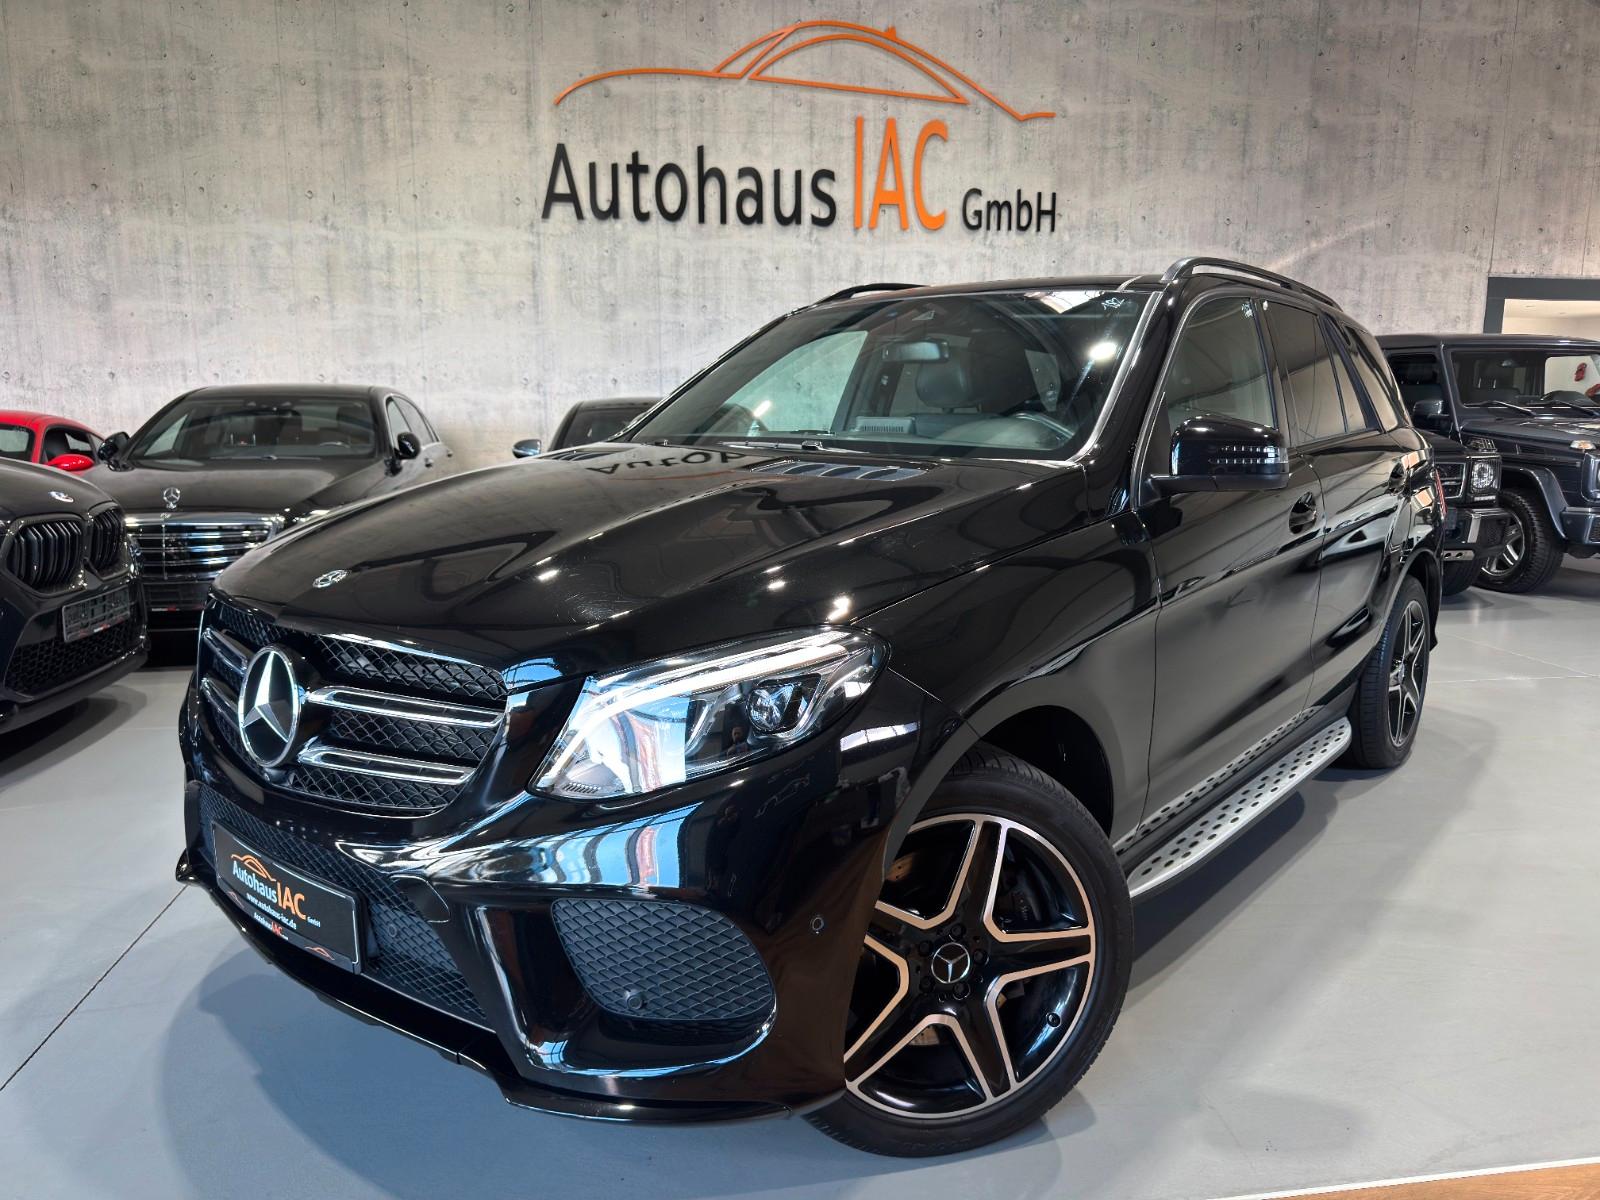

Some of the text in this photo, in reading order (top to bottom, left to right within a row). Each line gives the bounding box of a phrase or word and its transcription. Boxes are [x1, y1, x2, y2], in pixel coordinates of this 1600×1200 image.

[541, 115, 1057, 233] Autohaus IAC GmbH
[232, 860, 278, 903] Autohaus
[277, 881, 307, 920] IAC
